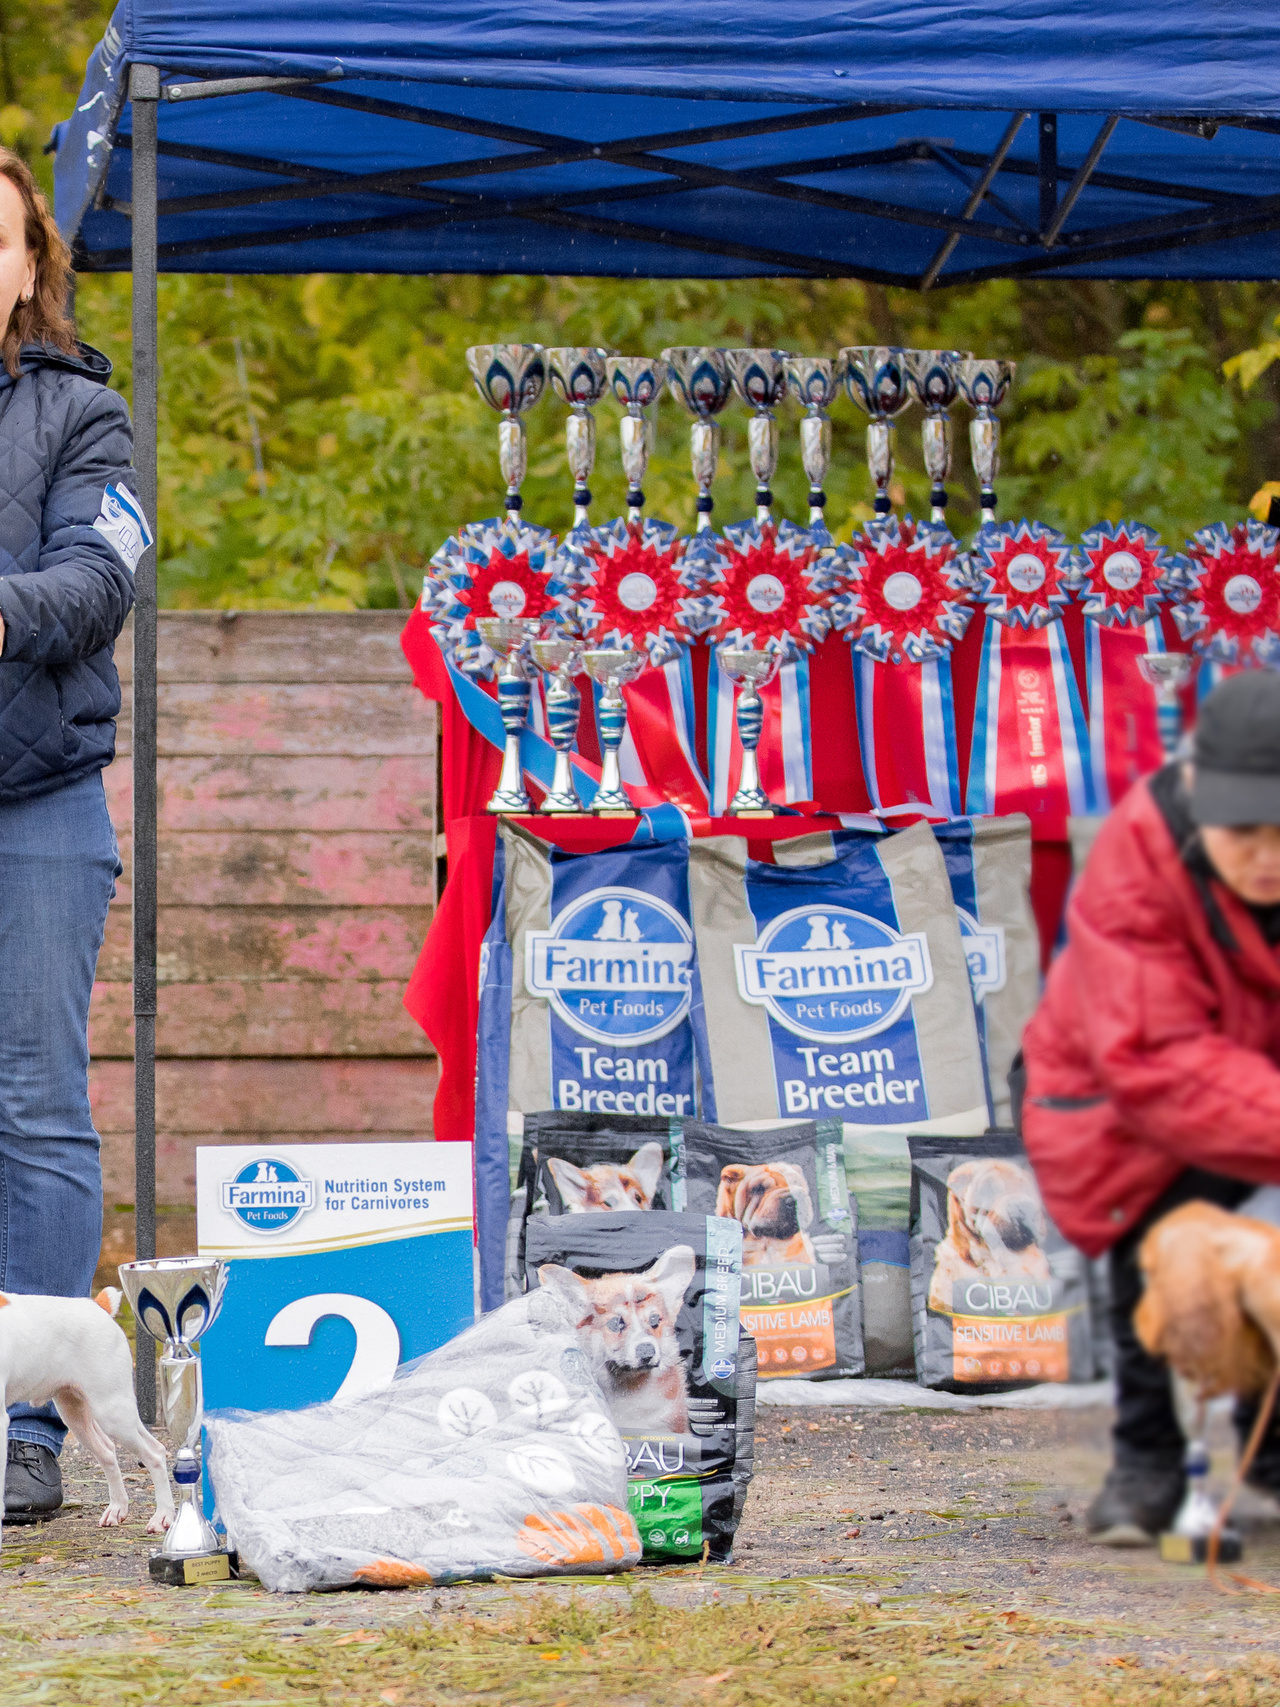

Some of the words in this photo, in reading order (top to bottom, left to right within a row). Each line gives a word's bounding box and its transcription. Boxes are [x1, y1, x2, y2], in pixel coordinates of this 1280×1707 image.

[546, 946, 689, 984] Farmina
[756, 955, 913, 990] Farmina
[580, 998, 607, 1016] Pet
[614, 998, 664, 1017] Foods
[796, 1003, 825, 1019] Pet
[831, 999, 882, 1018] Foods
[574, 1047, 669, 1083] Team
[796, 1047, 895, 1078] Team
[559, 1079, 691, 1117] Breeder
[783, 1072, 920, 1114] Breeder
[229, 1186, 305, 1205] Farmina
[325, 1179, 387, 1194] Nutrition
[394, 1178, 446, 1194] System
[247, 1211, 261, 1220] Pet
[264, 1211, 288, 1220] Foods
[325, 1197, 344, 1210] for
[351, 1196, 429, 1210] Carnivores
[717, 1247, 730, 1291] BREED
[965, 1283, 1053, 1311] CIBAU
[714, 1296, 728, 1353] MEDIUM
[790, 1310, 831, 1328] LAMB
[956, 1325, 1023, 1342] SENSITIVE
[1026, 1326, 1065, 1342] LAMB
[264, 1293, 400, 1404] 2
